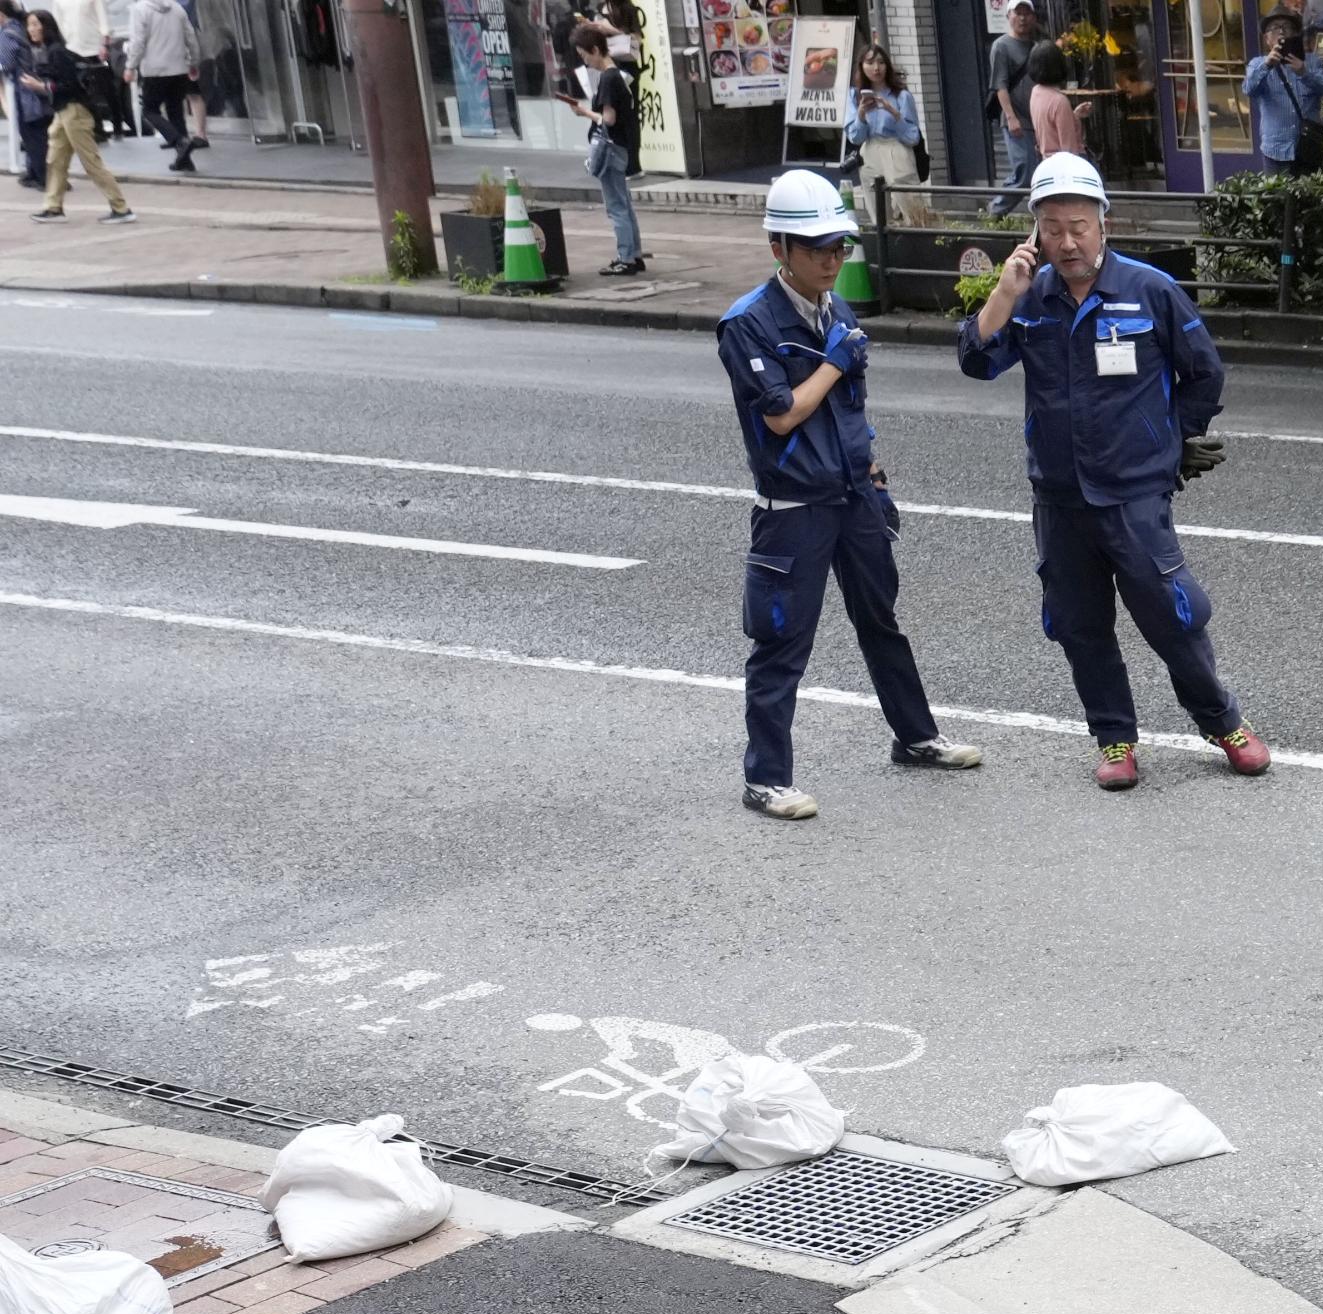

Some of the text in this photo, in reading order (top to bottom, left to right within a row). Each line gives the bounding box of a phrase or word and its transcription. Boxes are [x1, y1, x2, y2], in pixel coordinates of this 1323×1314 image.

[487, 15, 506, 29] SHOP
[481, 30, 511, 54] OPEN
[801, 90, 835, 101] MENTAI
[795, 107, 837, 122] WAGYU
